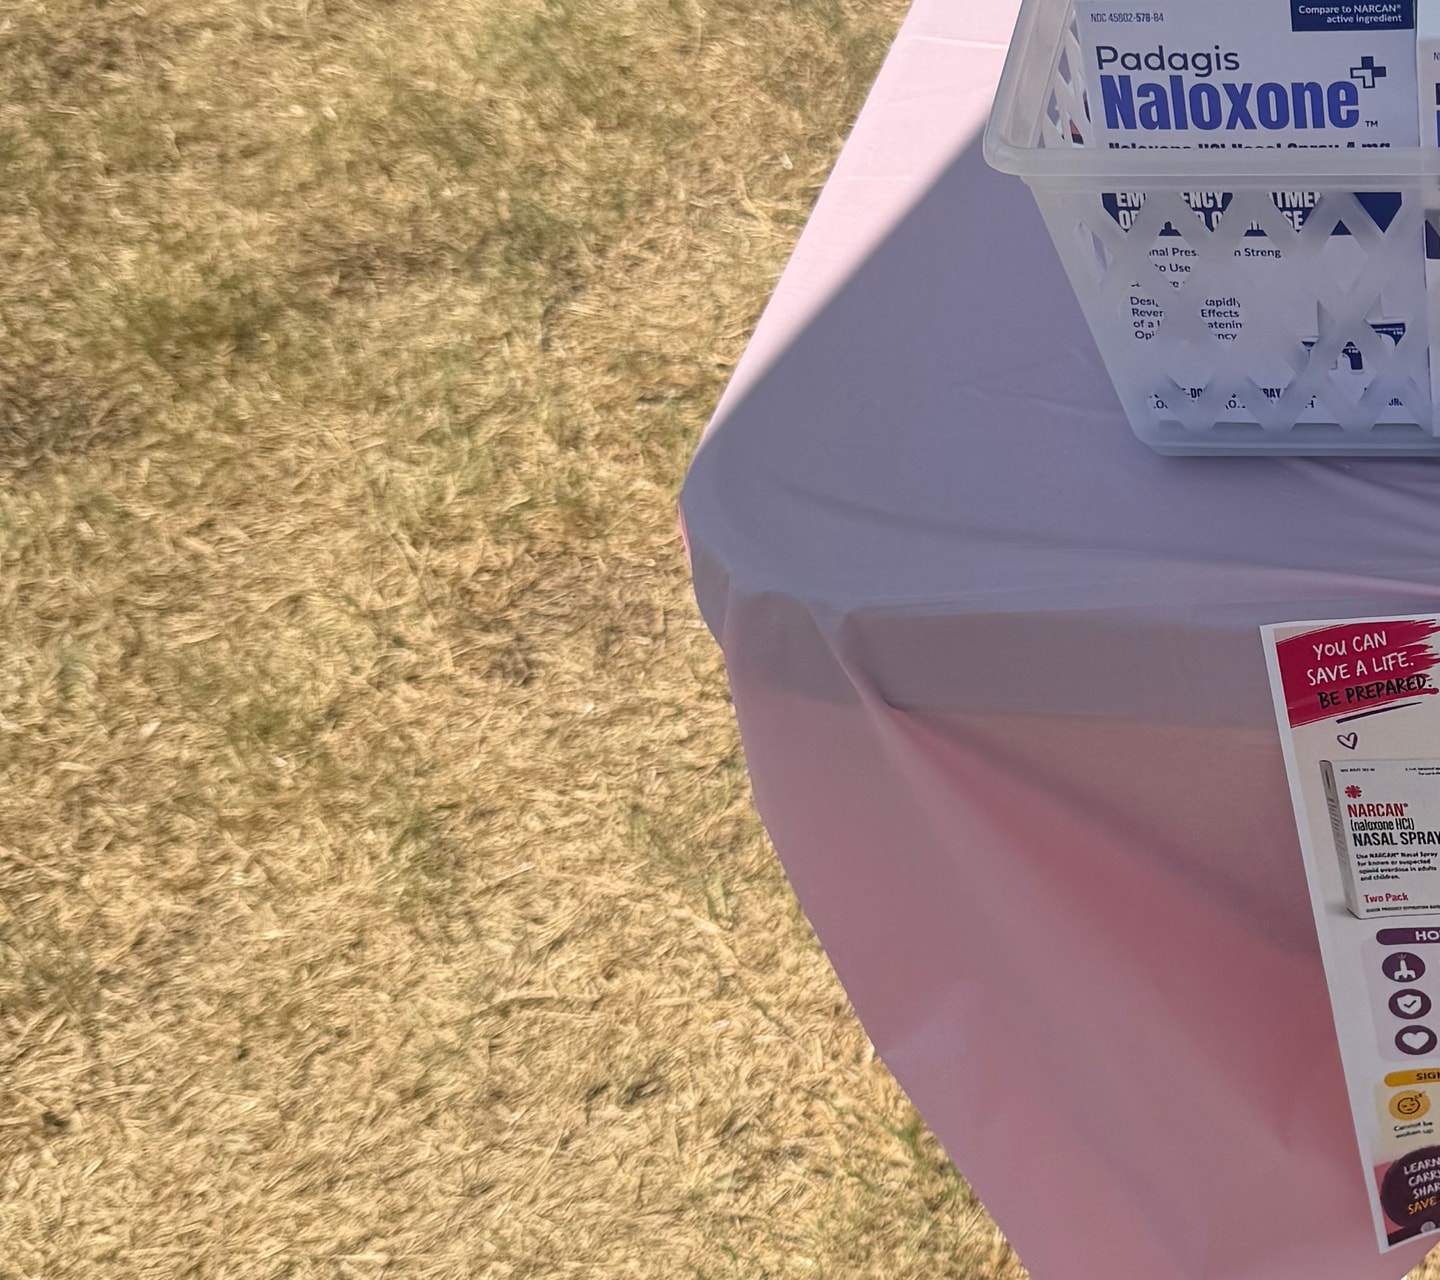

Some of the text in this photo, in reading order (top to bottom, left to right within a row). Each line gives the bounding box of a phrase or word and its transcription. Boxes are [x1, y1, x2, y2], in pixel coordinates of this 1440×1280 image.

[1091, 13, 1107, 22] NDC
[1298, 5, 1339, 16] Compare
[1342, 5, 1351, 13] to
[1326, 13, 1402, 25] active ingredient
[1095, 45, 1240, 77] Padagis
[1313, 630, 1387, 661] YOU CAN
[1306, 651, 1414, 687] SAVE A LIFE.
[1317, 673, 1432, 710] BE PREPARED.
[1350, 818, 1415, 832] (naloxone HCl)
[1352, 833, 1398, 846] NASAL
[1364, 893, 1408, 903] Two Pack
[1403, 1157, 1440, 1175] LEARN
[1407, 1198, 1438, 1216] SAVE
